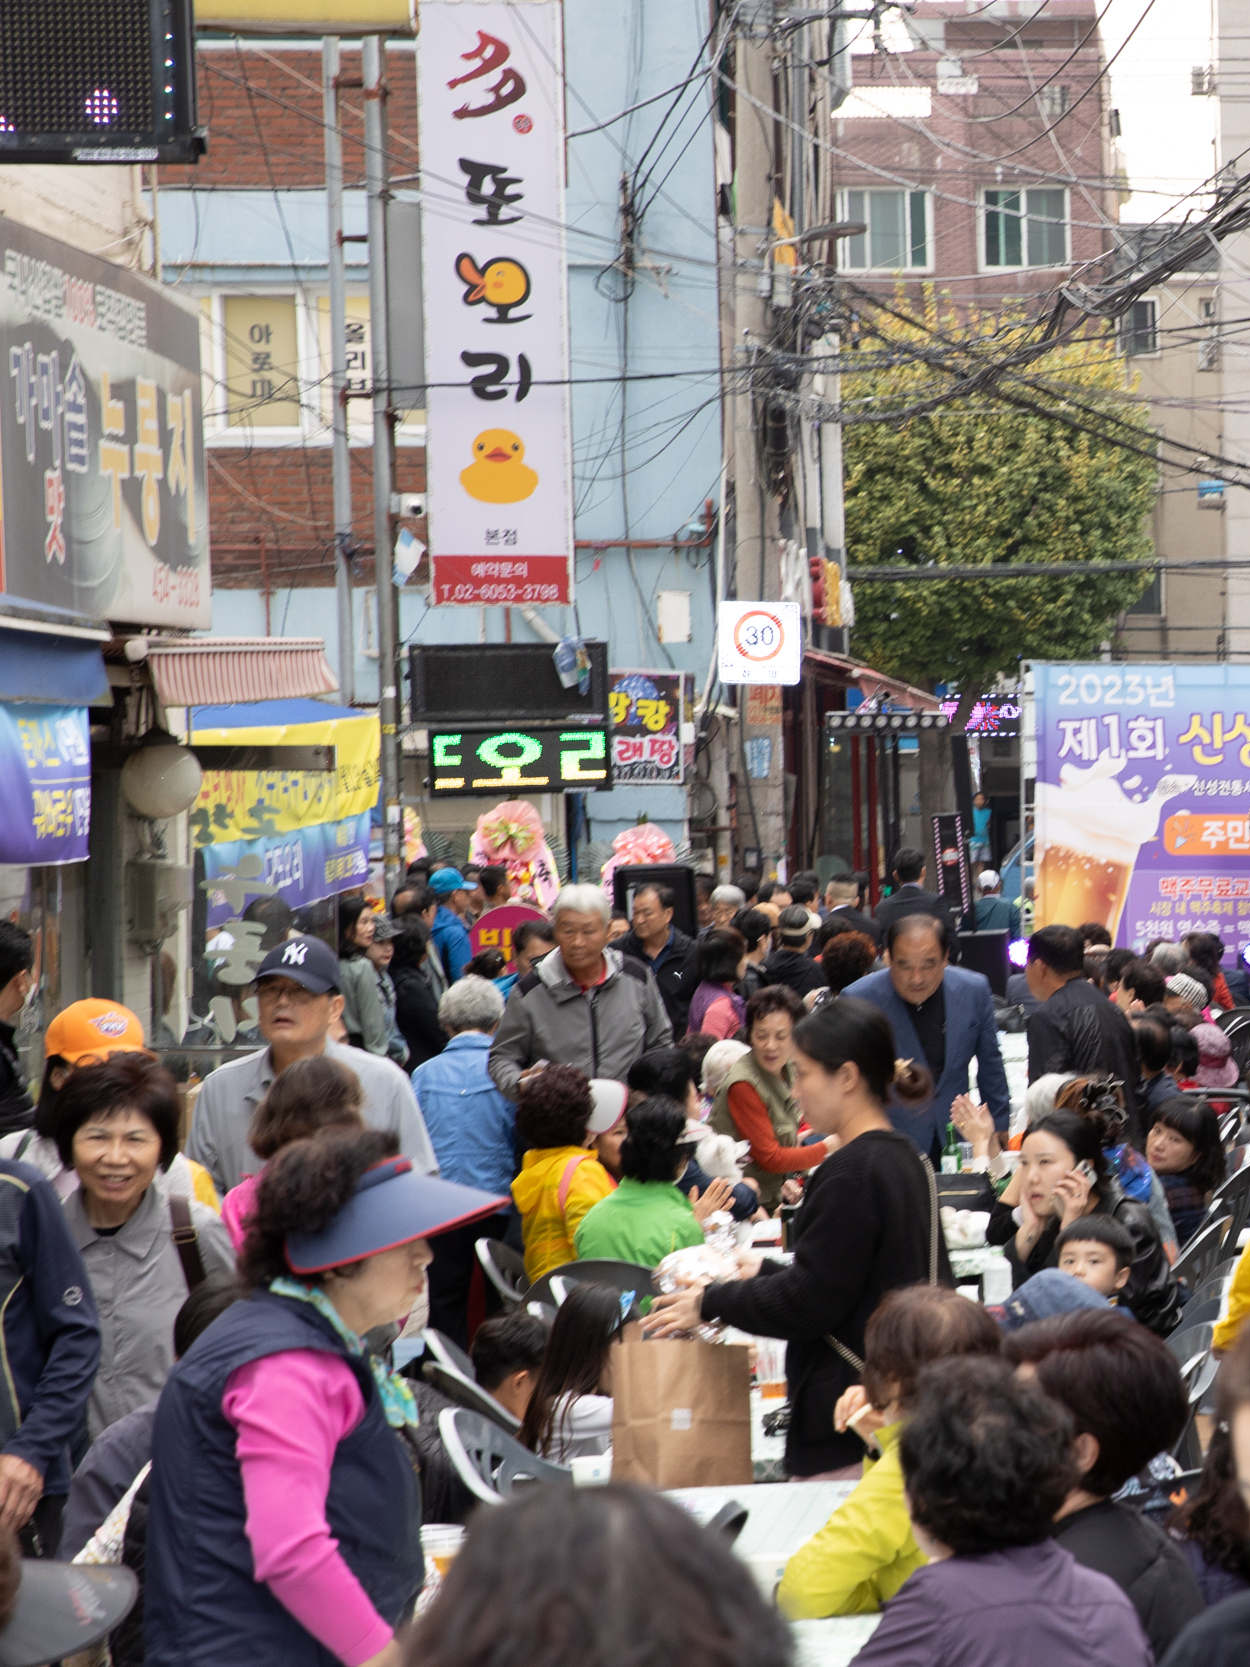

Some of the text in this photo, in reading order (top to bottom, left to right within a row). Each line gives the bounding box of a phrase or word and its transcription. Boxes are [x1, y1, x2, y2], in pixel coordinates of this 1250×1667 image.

[446, 30, 528, 120] 多
[746, 625, 774, 646] 30
[1057, 673, 1177, 708] 2023년
[1057, 713, 1166, 763] 제1회
